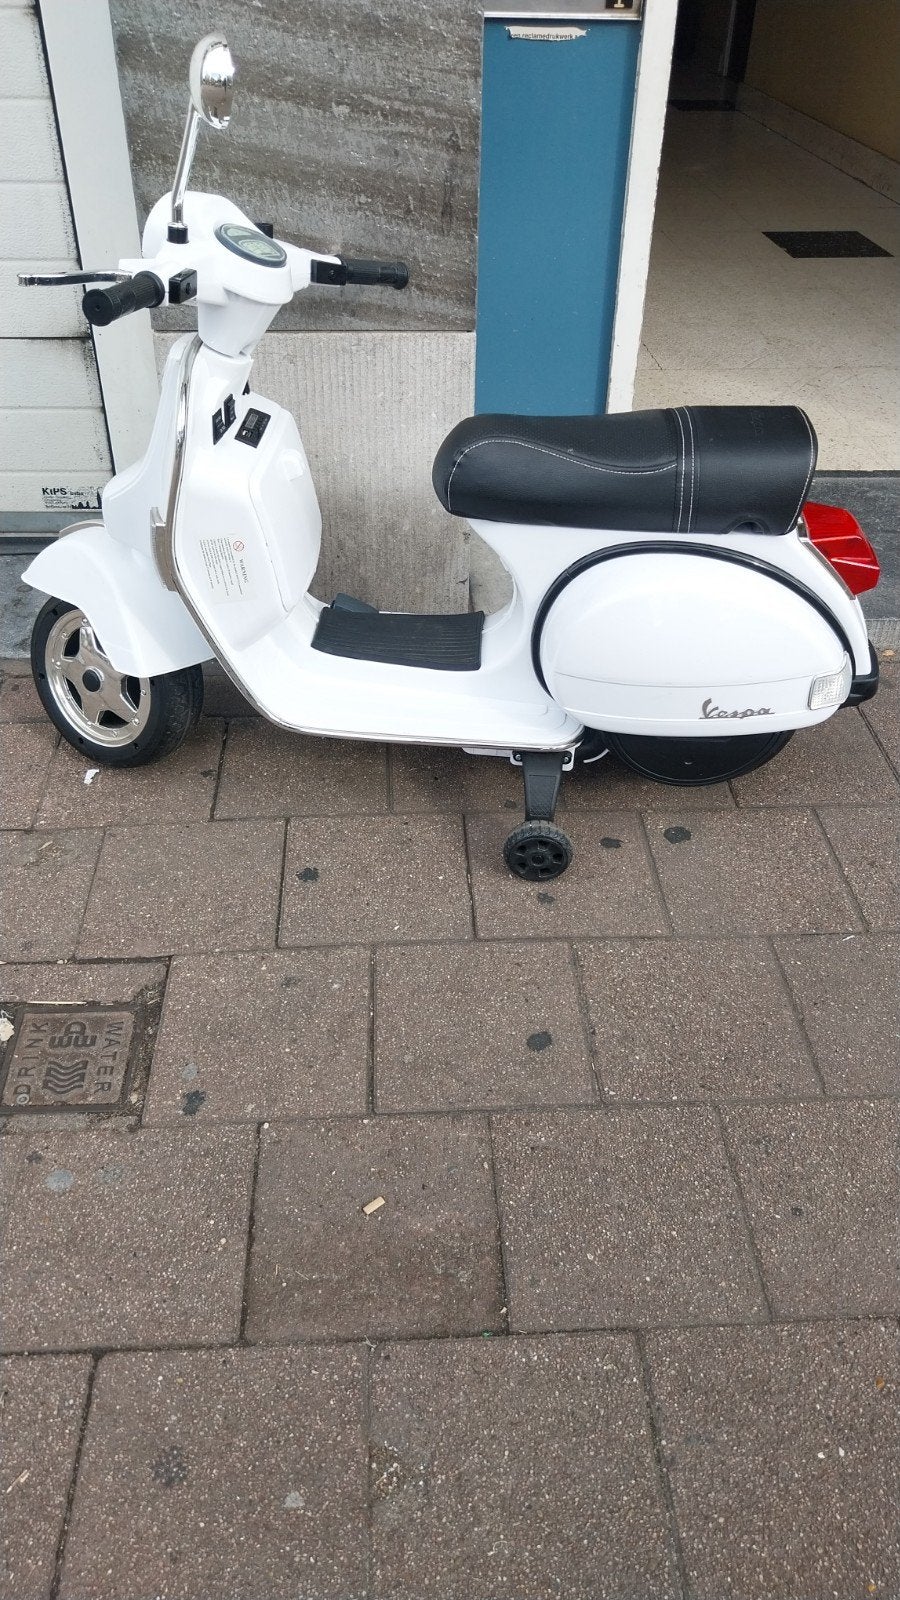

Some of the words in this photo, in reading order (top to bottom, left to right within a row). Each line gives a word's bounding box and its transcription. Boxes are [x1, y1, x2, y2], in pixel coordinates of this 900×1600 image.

[239, 558, 248, 583] WARNING
[698, 698, 775, 719] Vespa
[13, 1022, 49, 1094] DRINK
[94, 1021, 124, 1094] WATER
